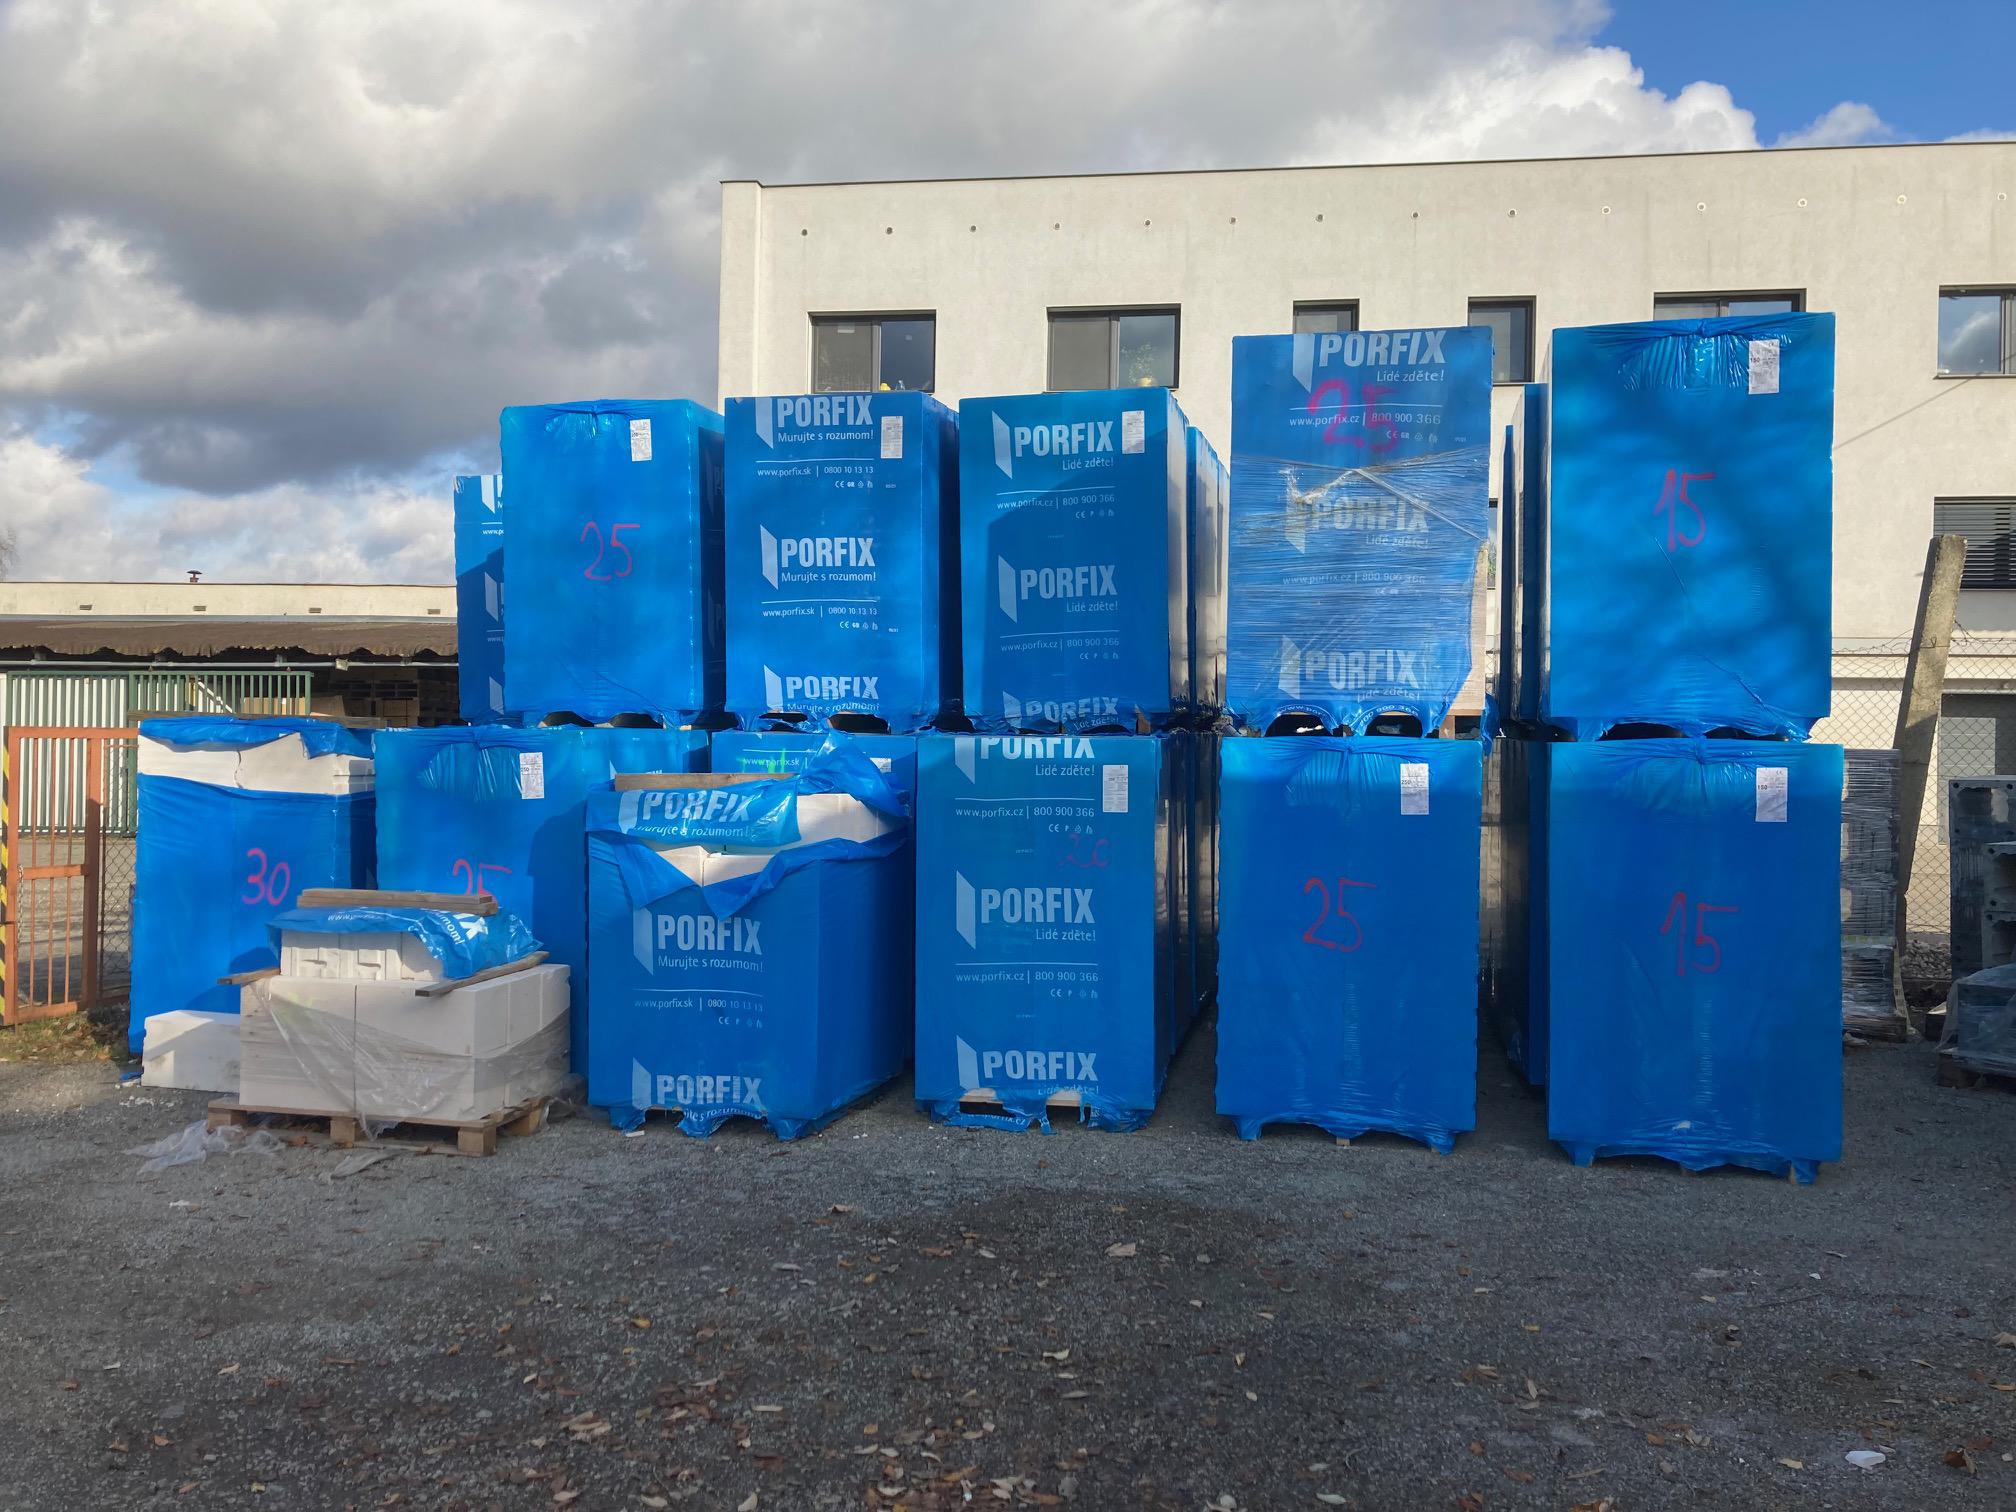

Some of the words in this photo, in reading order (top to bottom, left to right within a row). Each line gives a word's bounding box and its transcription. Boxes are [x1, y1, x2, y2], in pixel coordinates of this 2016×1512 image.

[1319, 330, 1448, 367] PORFIX
[1377, 371, 1400, 382] Lidé
[1402, 369, 1444, 382] zděte!
[777, 395, 873, 428] PORFIX
[1289, 414, 1359, 427] www.porfix.cz
[1371, 412, 1392, 422] 800
[1395, 413, 1413, 423] 900
[1416, 414, 1441, 425] 366
[1307, 377, 1400, 453] 25
[778, 432, 815, 443] Murujte
[826, 429, 874, 440] rozumom!
[1014, 421, 1113, 457] PORFIX
[757, 466, 812, 477] www.porfix.sk
[824, 466, 841, 474] 0800
[844, 466, 852, 474] 10
[854, 466, 863, 474] 13
[1062, 458, 1082, 470] Lidé
[1084, 457, 1114, 468] zděte!
[997, 496, 1053, 509] www.porfix.cz
[1062, 497, 1079, 506] 800
[1081, 495, 1097, 505] 900
[1653, 468, 1717, 552] 15
[580, 520, 641, 582] 25
[781, 537, 876, 568] PORFIX
[781, 572, 818, 583] Murujte
[822, 573, 826, 581] s
[829, 571, 876, 581] rozumom!
[1020, 565, 1118, 600] PORFIX
[762, 606, 815, 618] www.porfix.sk
[1066, 602, 1086, 612] Lidé
[1088, 600, 1118, 612] zděte!
[1000, 640, 1058, 652] www.porfix.cz
[1066, 639, 1083, 648] 800
[1085, 638, 1100, 647] 900
[1305, 649, 1419, 690] PORFIX
[785, 675, 879, 700] PORFIX
[1026, 696, 1119, 724] PORFIX
[1035, 765, 1057, 776] Lidé
[1060, 764, 1095, 776] zděte!
[642, 789, 752, 823] PORFIX
[956, 807, 1024, 819] www.porfix.cz
[1033, 806, 1052, 816] 800
[1055, 806, 1073, 816] 900
[1075, 807, 1095, 817] 366
[691, 826, 752, 839] rozumom!
[241, 847, 291, 906] 30
[981, 887, 1095, 924] PORFIX
[1303, 877, 1377, 953] 25
[657, 914, 763, 955] PORFIX
[1036, 928, 1058, 940] Lidé
[1062, 929, 1096, 941] zděte!
[1660, 890, 1739, 977] 15
[658, 955, 699, 971] Murujte
[702, 958, 708, 968] s
[710, 958, 764, 972] rozumom!
[956, 970, 1025, 983] www.porfix.cz
[1035, 971, 1054, 981] 800
[1057, 971, 1076, 981] 900
[1079, 972, 1098, 982] 366
[634, 997, 693, 1010] www.porfix.sk
[708, 998, 727, 1008] 0800
[983, 1050, 1099, 1081] PORFIX
[656, 1074, 766, 1110] PORFIX
